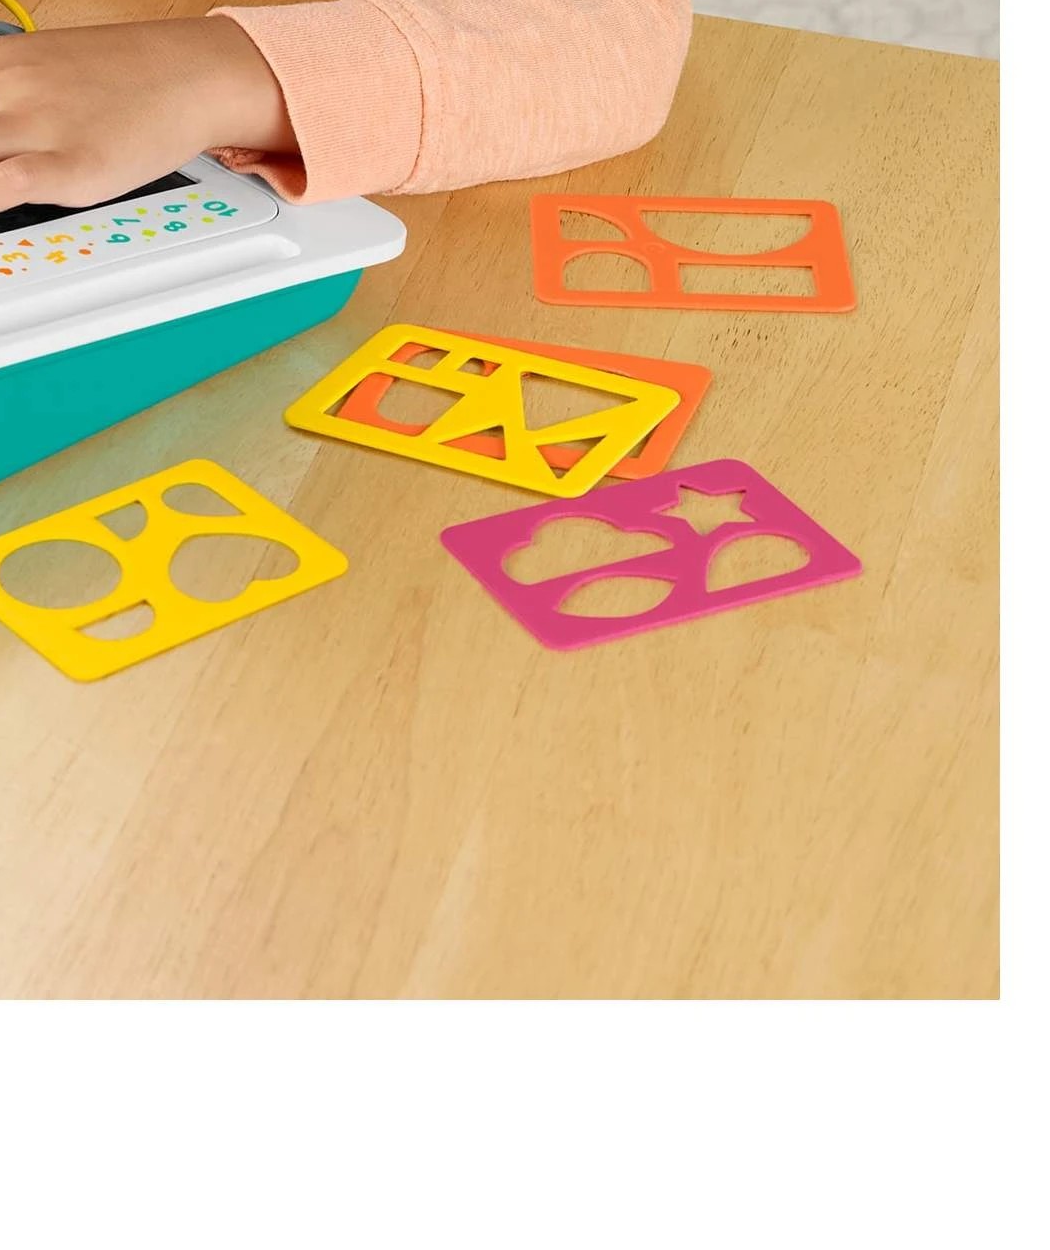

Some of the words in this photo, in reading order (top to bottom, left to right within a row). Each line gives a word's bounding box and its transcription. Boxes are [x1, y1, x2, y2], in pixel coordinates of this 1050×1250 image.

[202, 200, 239, 218] 10
[112, 217, 141, 227] 7
[163, 220, 188, 233] 8
[44, 233, 75, 245] 5
[1, 250, 30, 263] 3
[45, 249, 69, 265] 4
